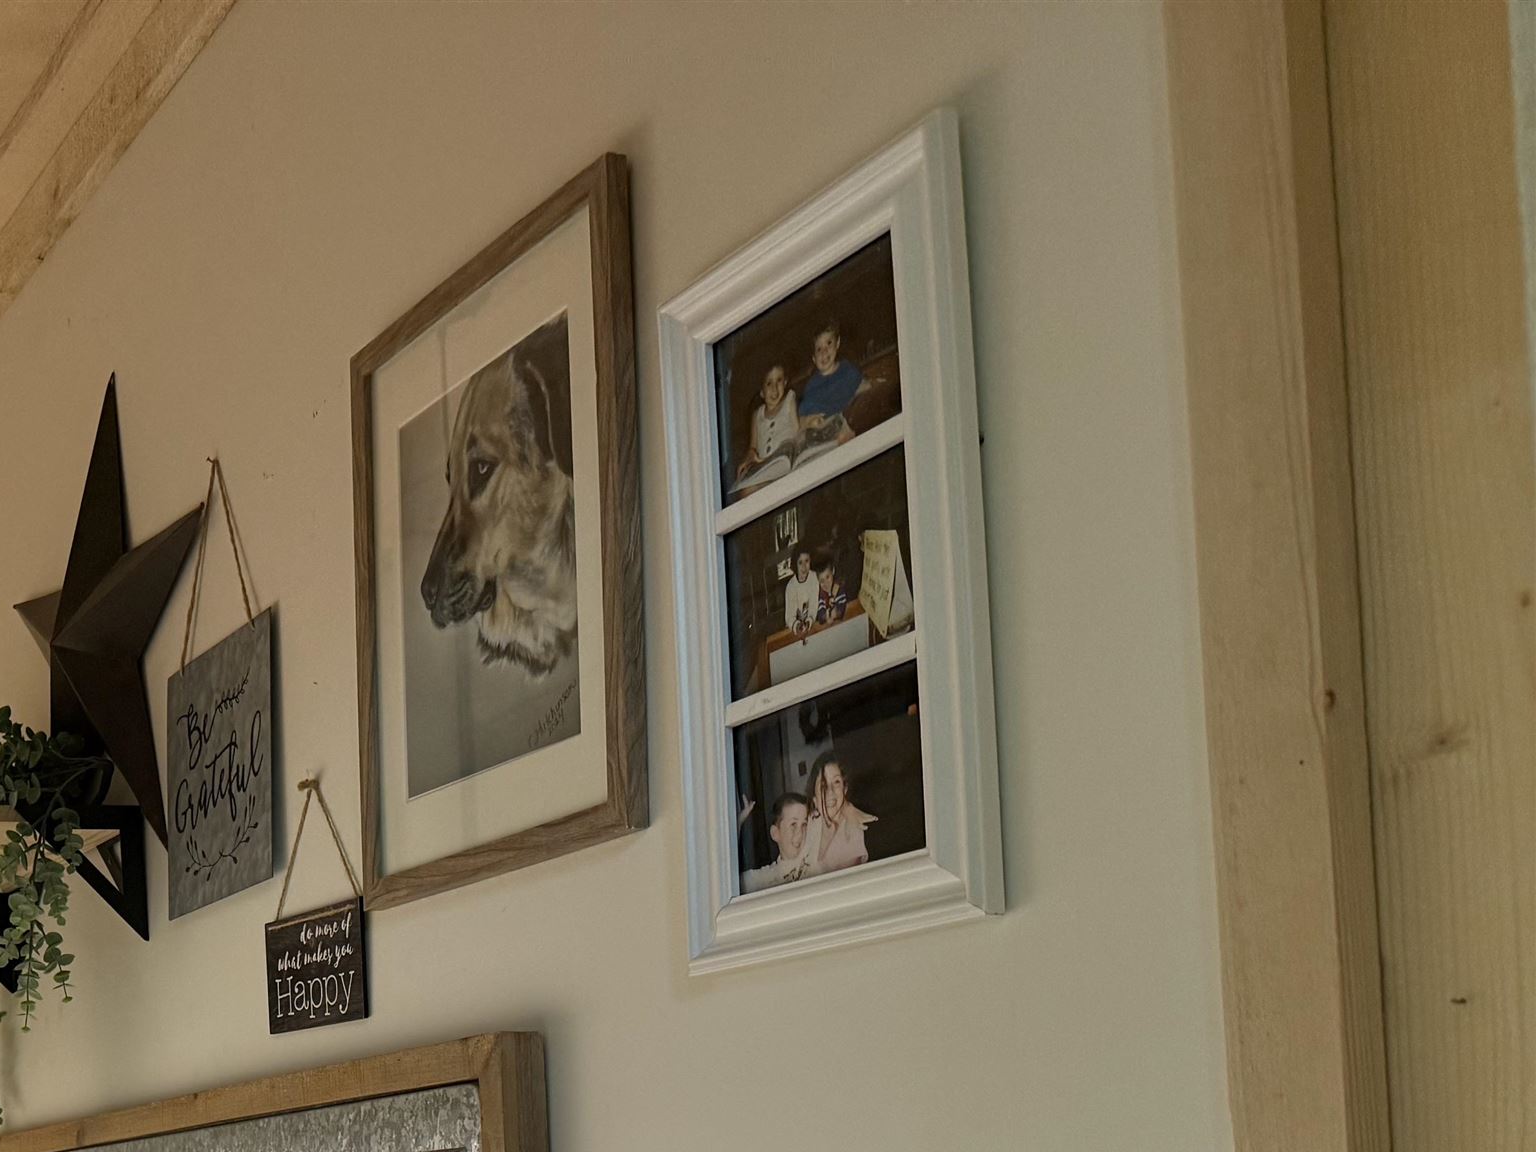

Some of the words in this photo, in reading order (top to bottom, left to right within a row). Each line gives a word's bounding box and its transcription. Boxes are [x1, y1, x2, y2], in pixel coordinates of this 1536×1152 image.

[177, 704, 217, 770] Be
[175, 710, 264, 833] Grateful
[300, 922, 313, 944] do
[315, 921, 339, 938] more
[341, 911, 352, 939] of
[277, 949, 302, 971] what
[304, 941, 333, 965] makes
[335, 943, 353, 968] you
[275, 970, 355, 1019] Happy
